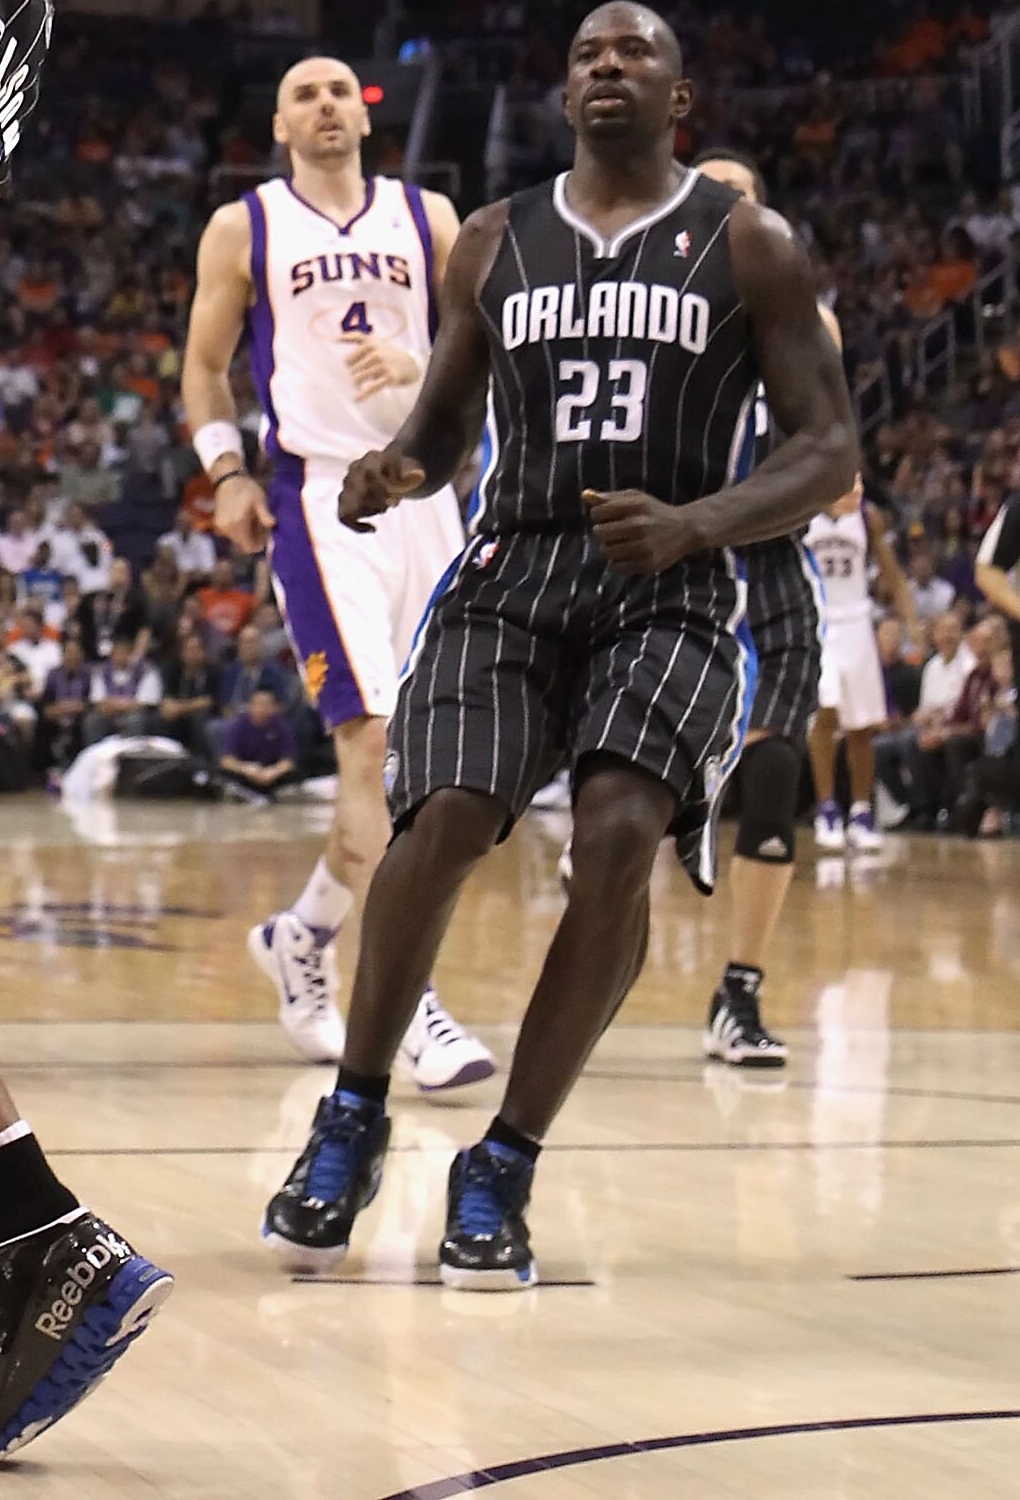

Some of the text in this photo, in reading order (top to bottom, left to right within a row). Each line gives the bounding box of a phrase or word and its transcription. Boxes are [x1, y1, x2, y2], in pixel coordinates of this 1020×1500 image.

[291, 251, 412, 296] SUNS
[340, 301, 373, 335] 4
[501, 280, 711, 356] ORLANDO
[555, 358, 647, 444] 23
[34, 1232, 131, 1341] Reebok
